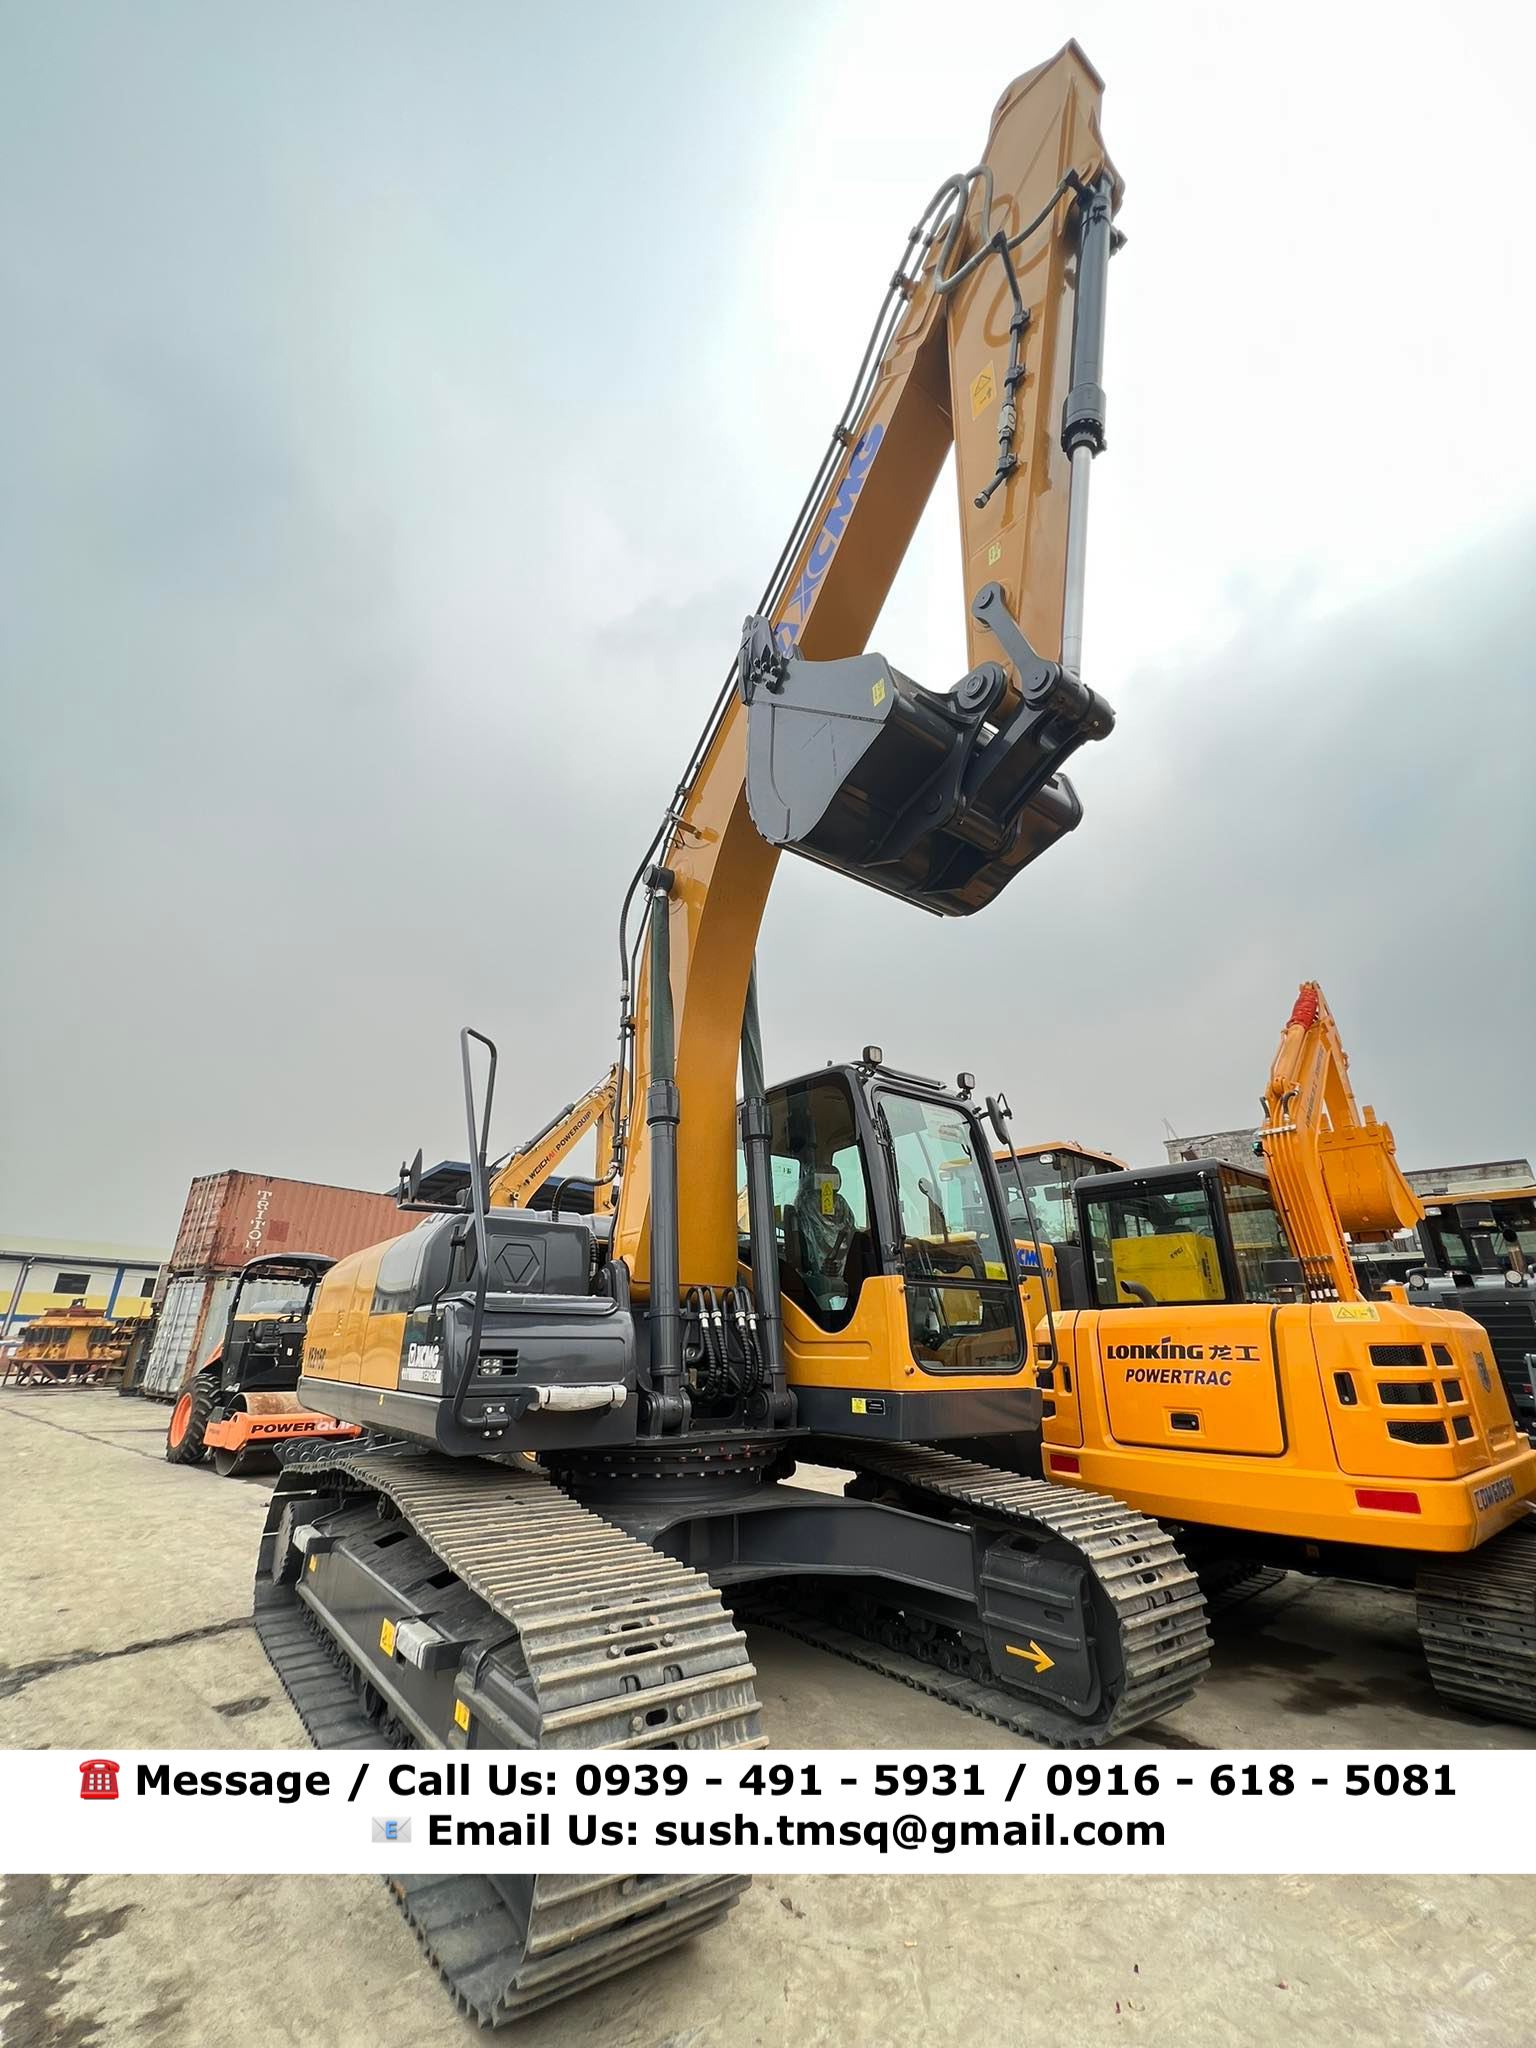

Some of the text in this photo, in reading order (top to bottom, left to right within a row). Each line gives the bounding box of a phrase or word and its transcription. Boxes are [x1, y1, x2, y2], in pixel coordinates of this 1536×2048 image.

[788, 423, 885, 622] XCMG
[1209, 1345, 1261, 1361] 龙工
[1126, 1368, 1232, 1386] POWERTRAC
